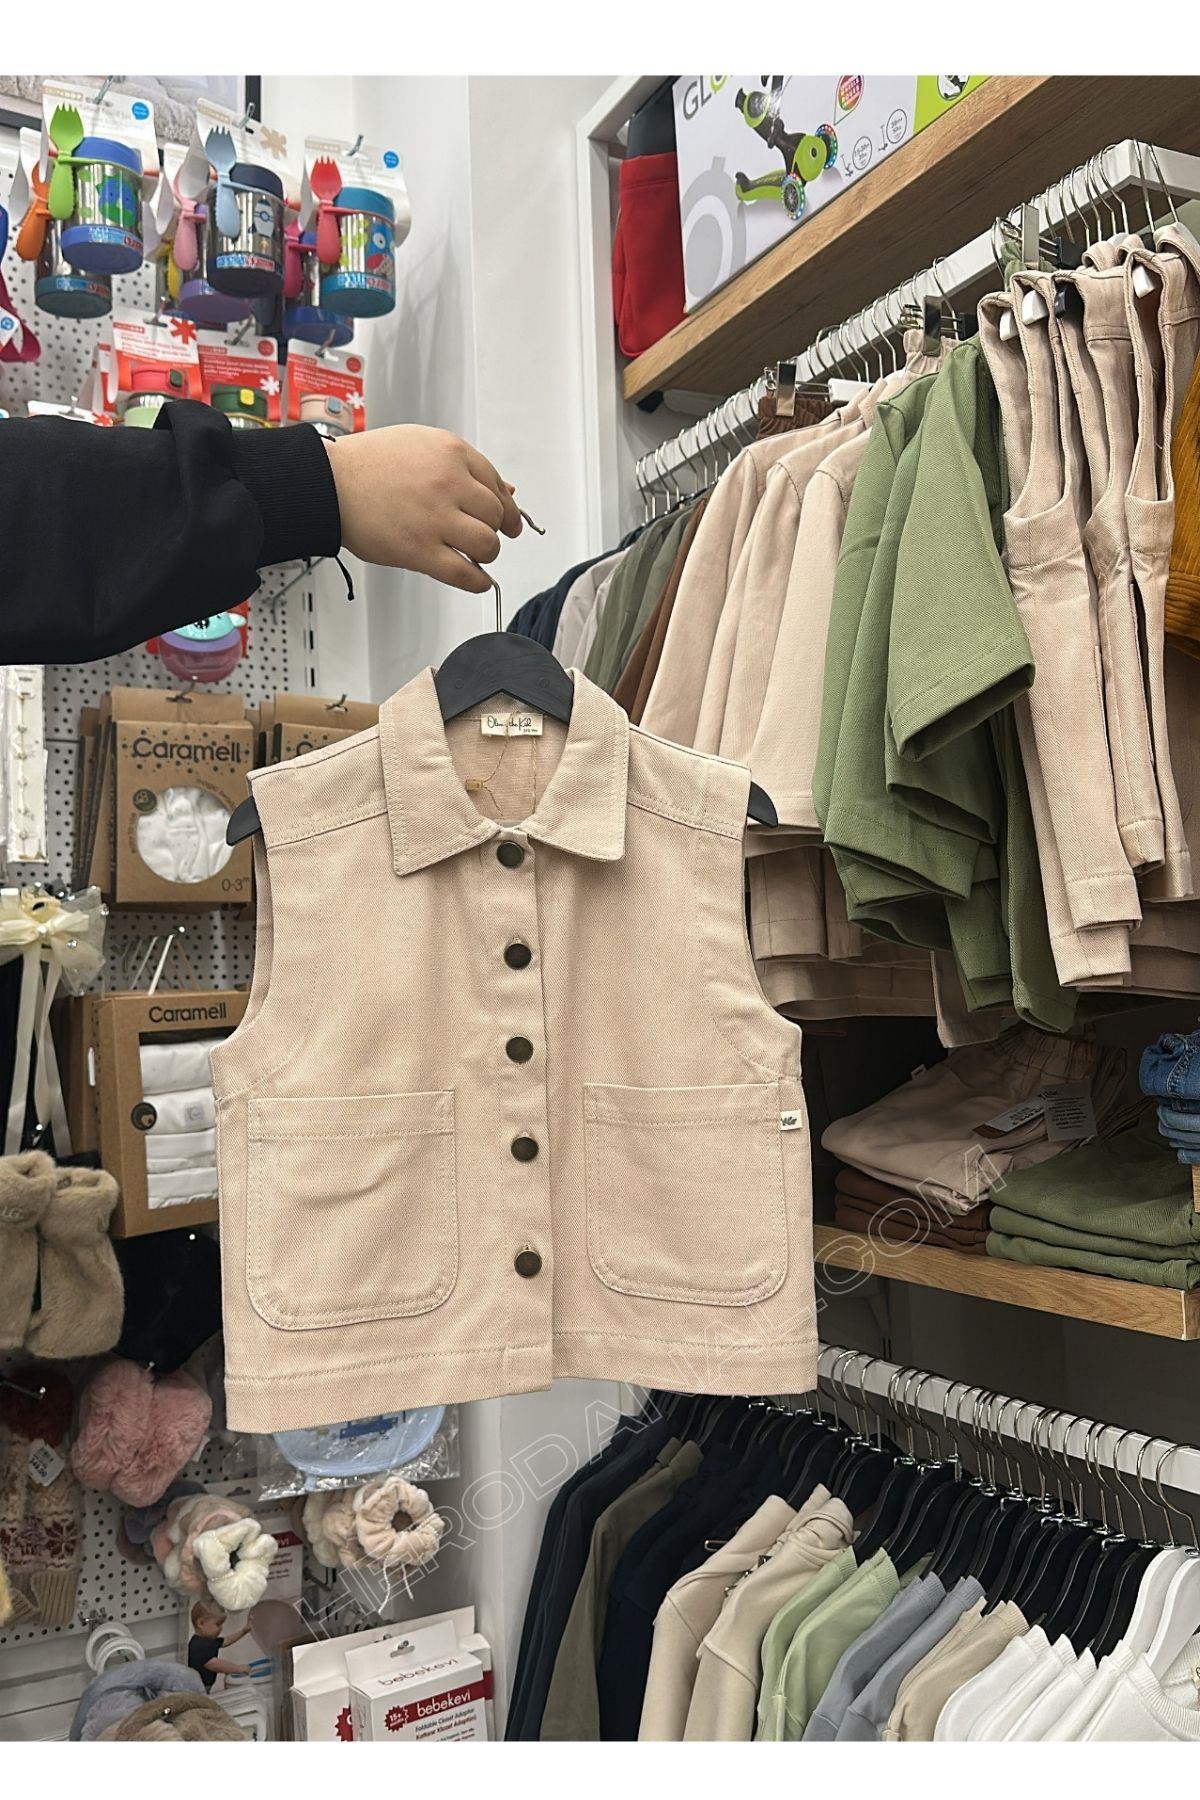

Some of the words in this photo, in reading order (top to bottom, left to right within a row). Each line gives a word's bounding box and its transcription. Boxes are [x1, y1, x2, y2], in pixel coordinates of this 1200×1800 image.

[133, 737, 242, 763] Caramell
[148, 1002, 227, 1023] Caramell
[378, 1658, 459, 1686] bebekevi
[416, 1688, 471, 1717] bebekevi
